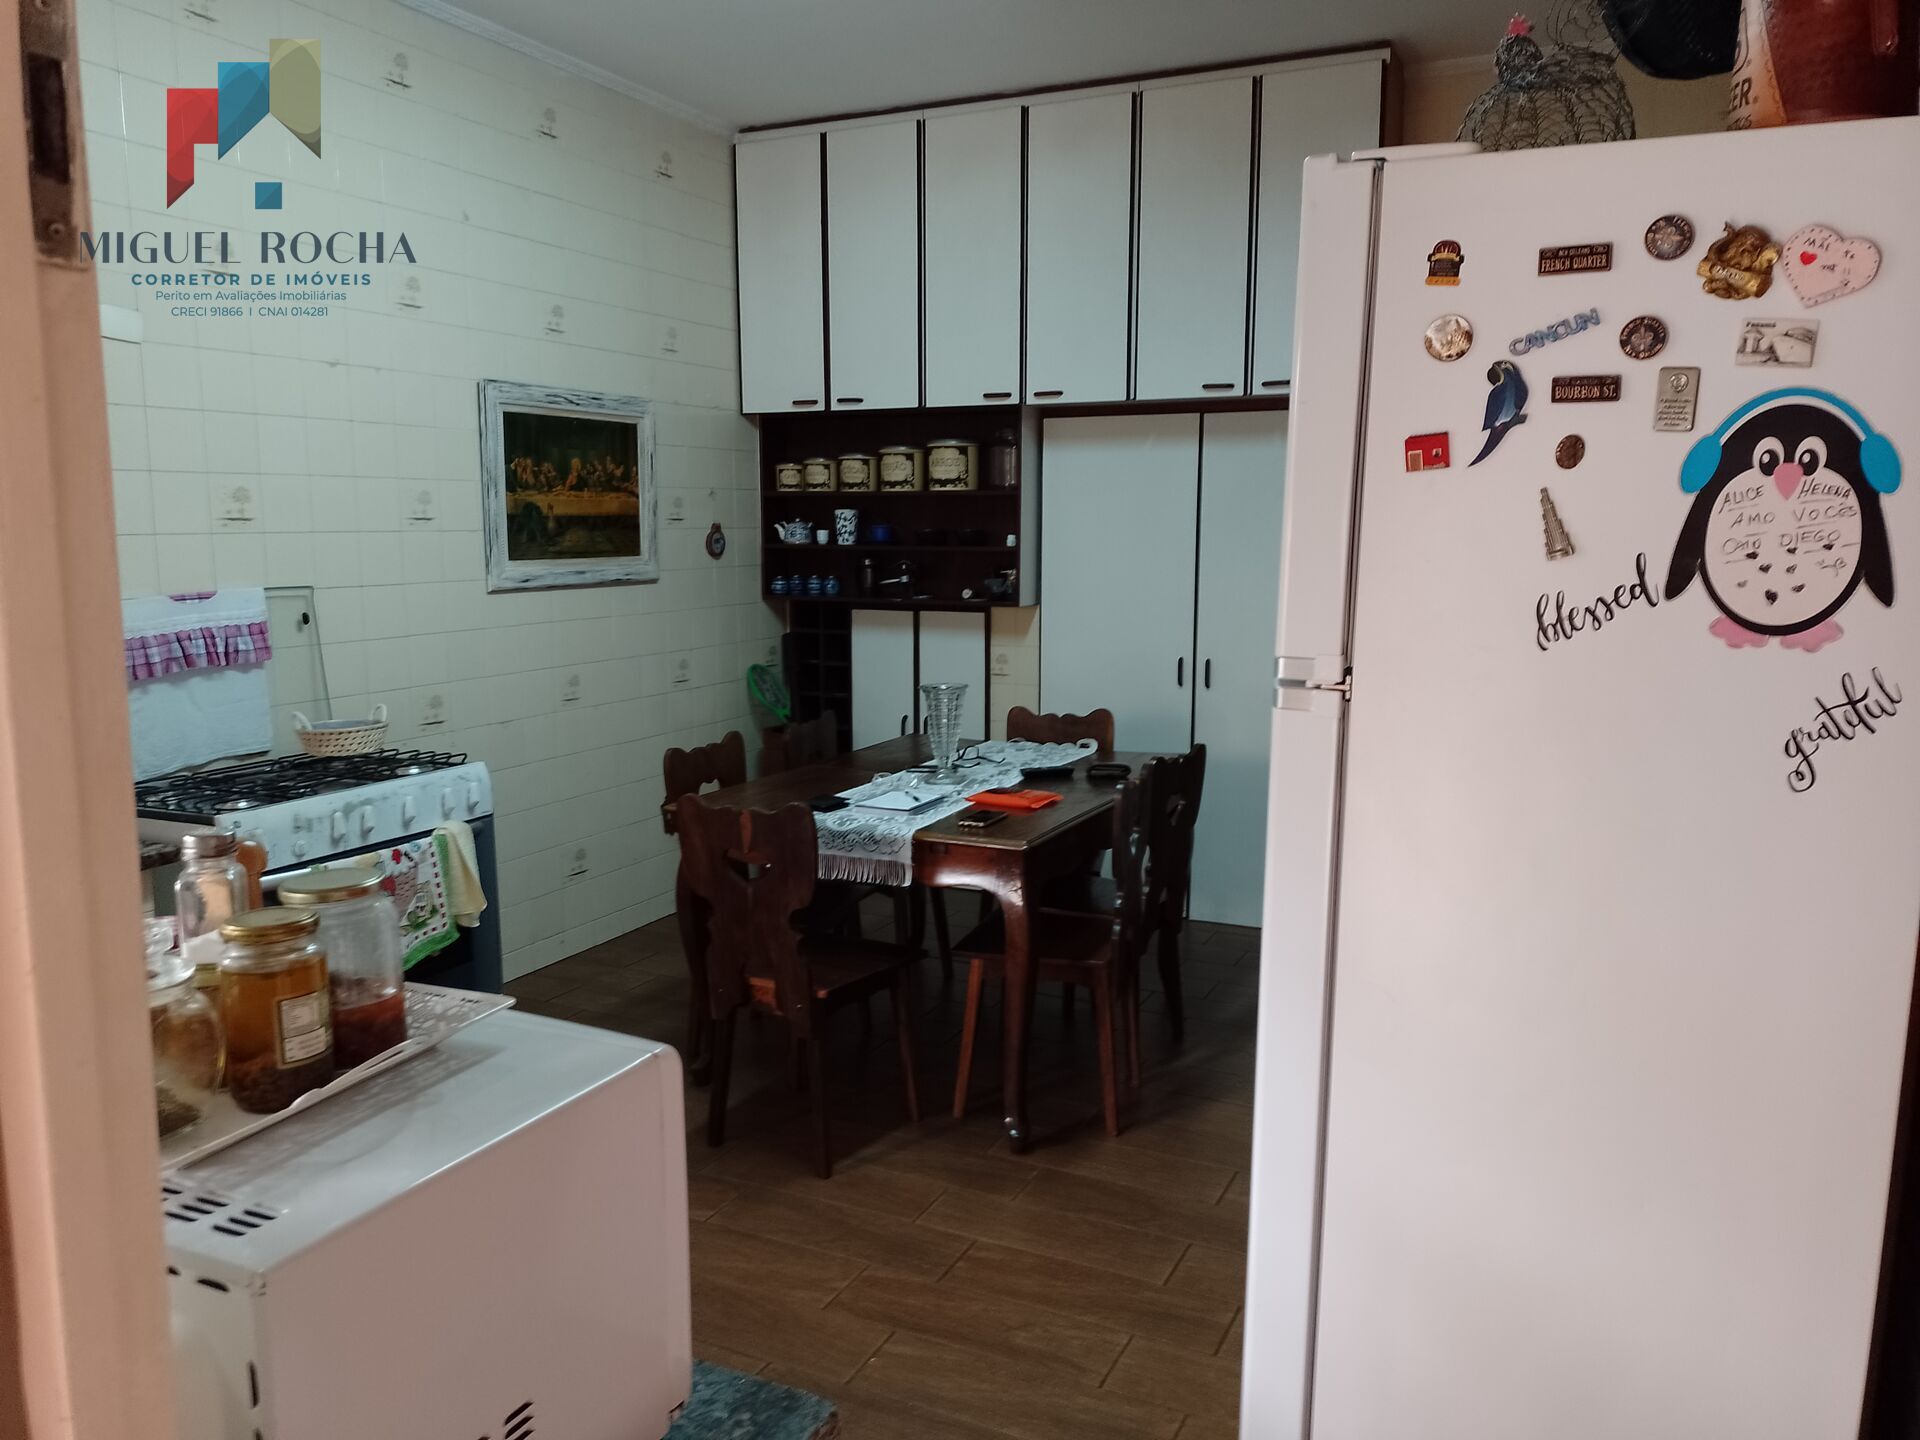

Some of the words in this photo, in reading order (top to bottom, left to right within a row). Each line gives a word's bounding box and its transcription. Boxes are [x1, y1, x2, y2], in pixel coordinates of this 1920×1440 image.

[1540, 257, 1571, 273] FRENCH
[1573, 253, 1608, 269] QUARTER
[1509, 307, 1602, 357] CANCUN
[1555, 385, 1601, 400] BOURBON
[1718, 484, 1766, 515] ALICE
[1797, 477, 1853, 500] HELENA
[1730, 510, 1776, 529] AMO
[1778, 529, 1841, 549] DIEGO
[1535, 552, 1660, 652] blessed
[1784, 666, 1903, 793] grateful
